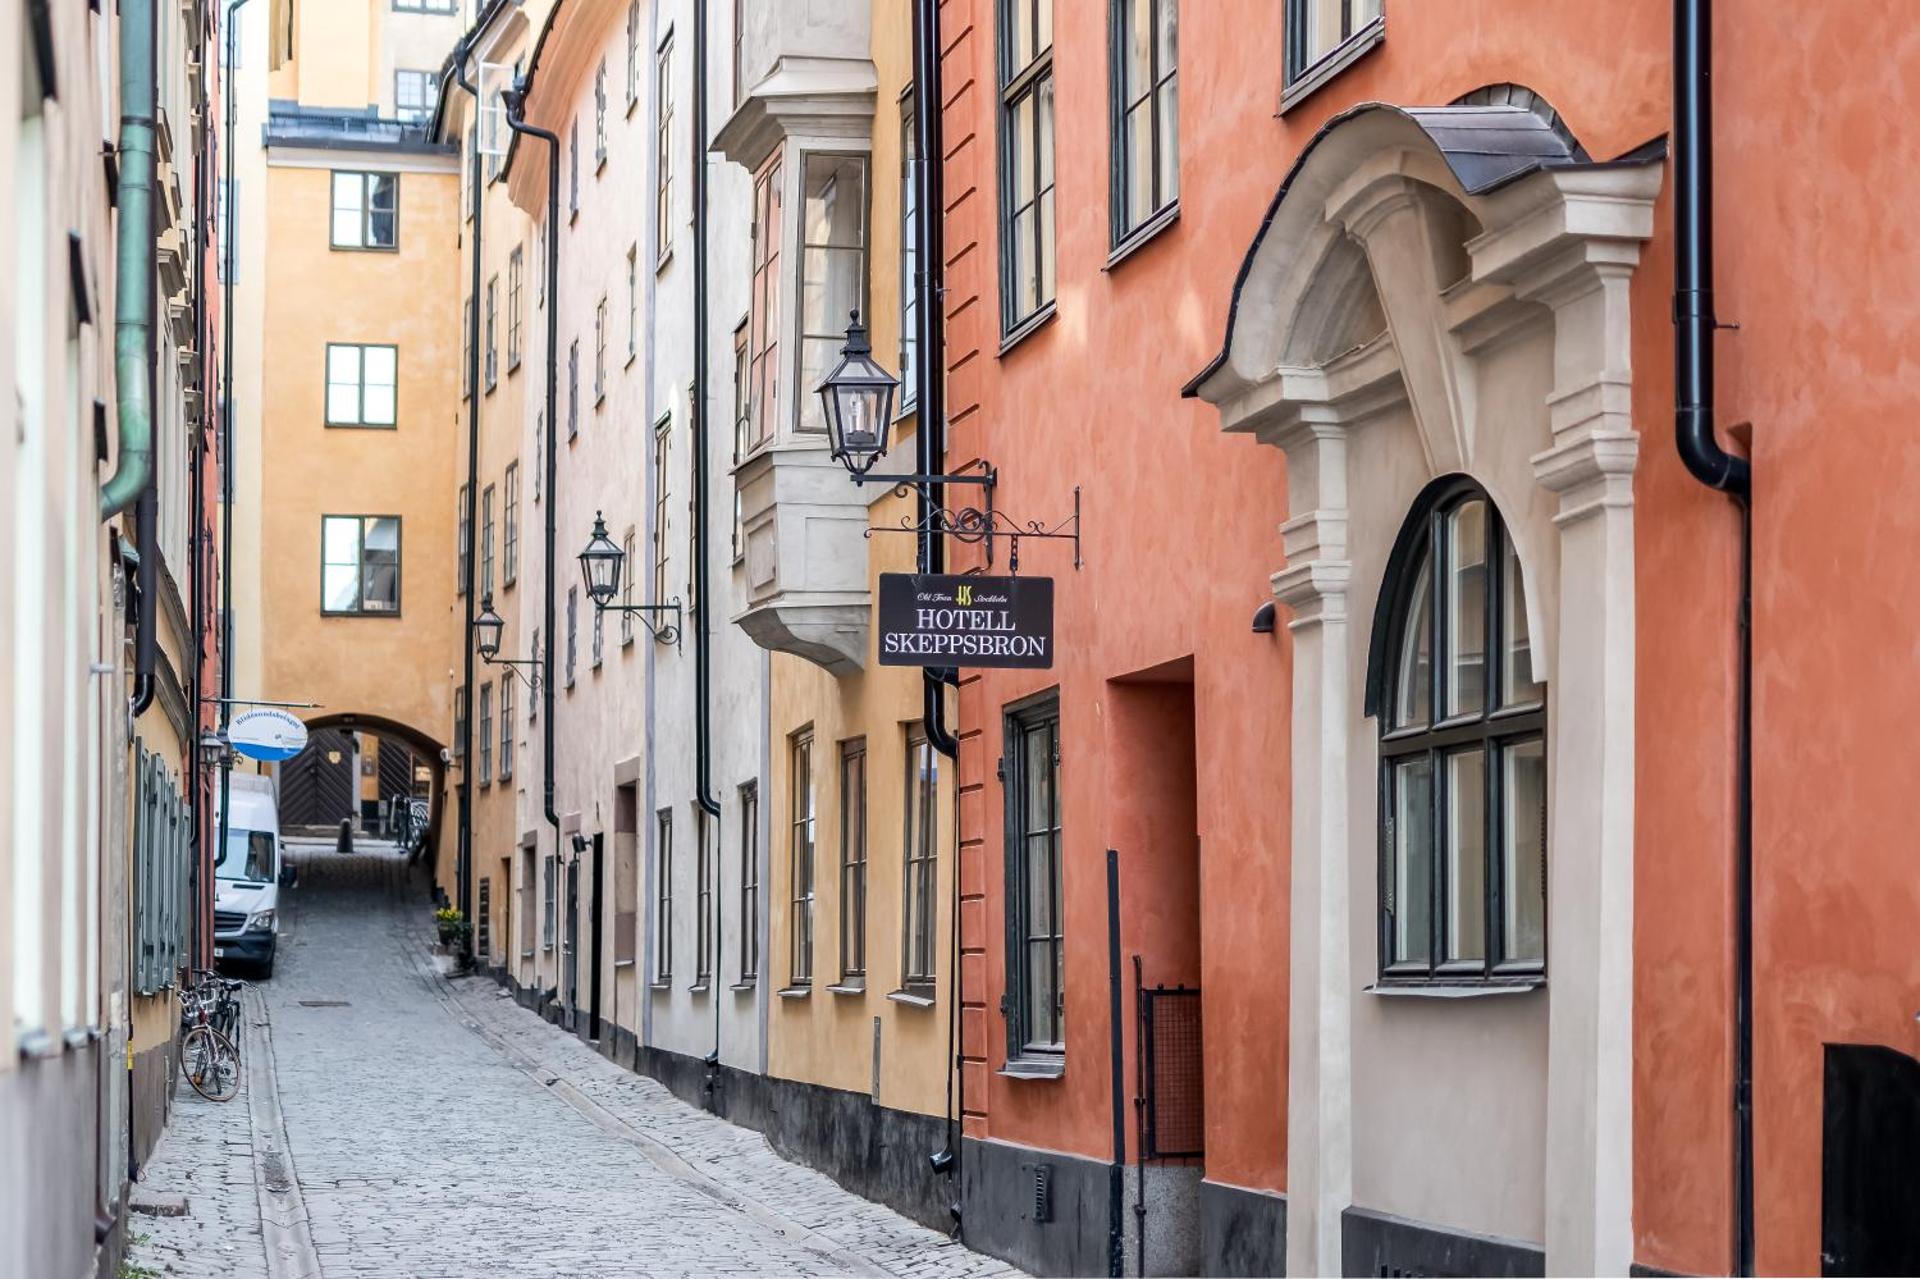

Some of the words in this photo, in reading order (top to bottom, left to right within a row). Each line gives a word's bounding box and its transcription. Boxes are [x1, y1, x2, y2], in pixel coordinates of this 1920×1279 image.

[917, 592, 931, 601] Old
[916, 608, 1016, 631] HOTELL
[885, 632, 1046, 656] SKEPPSBRON
